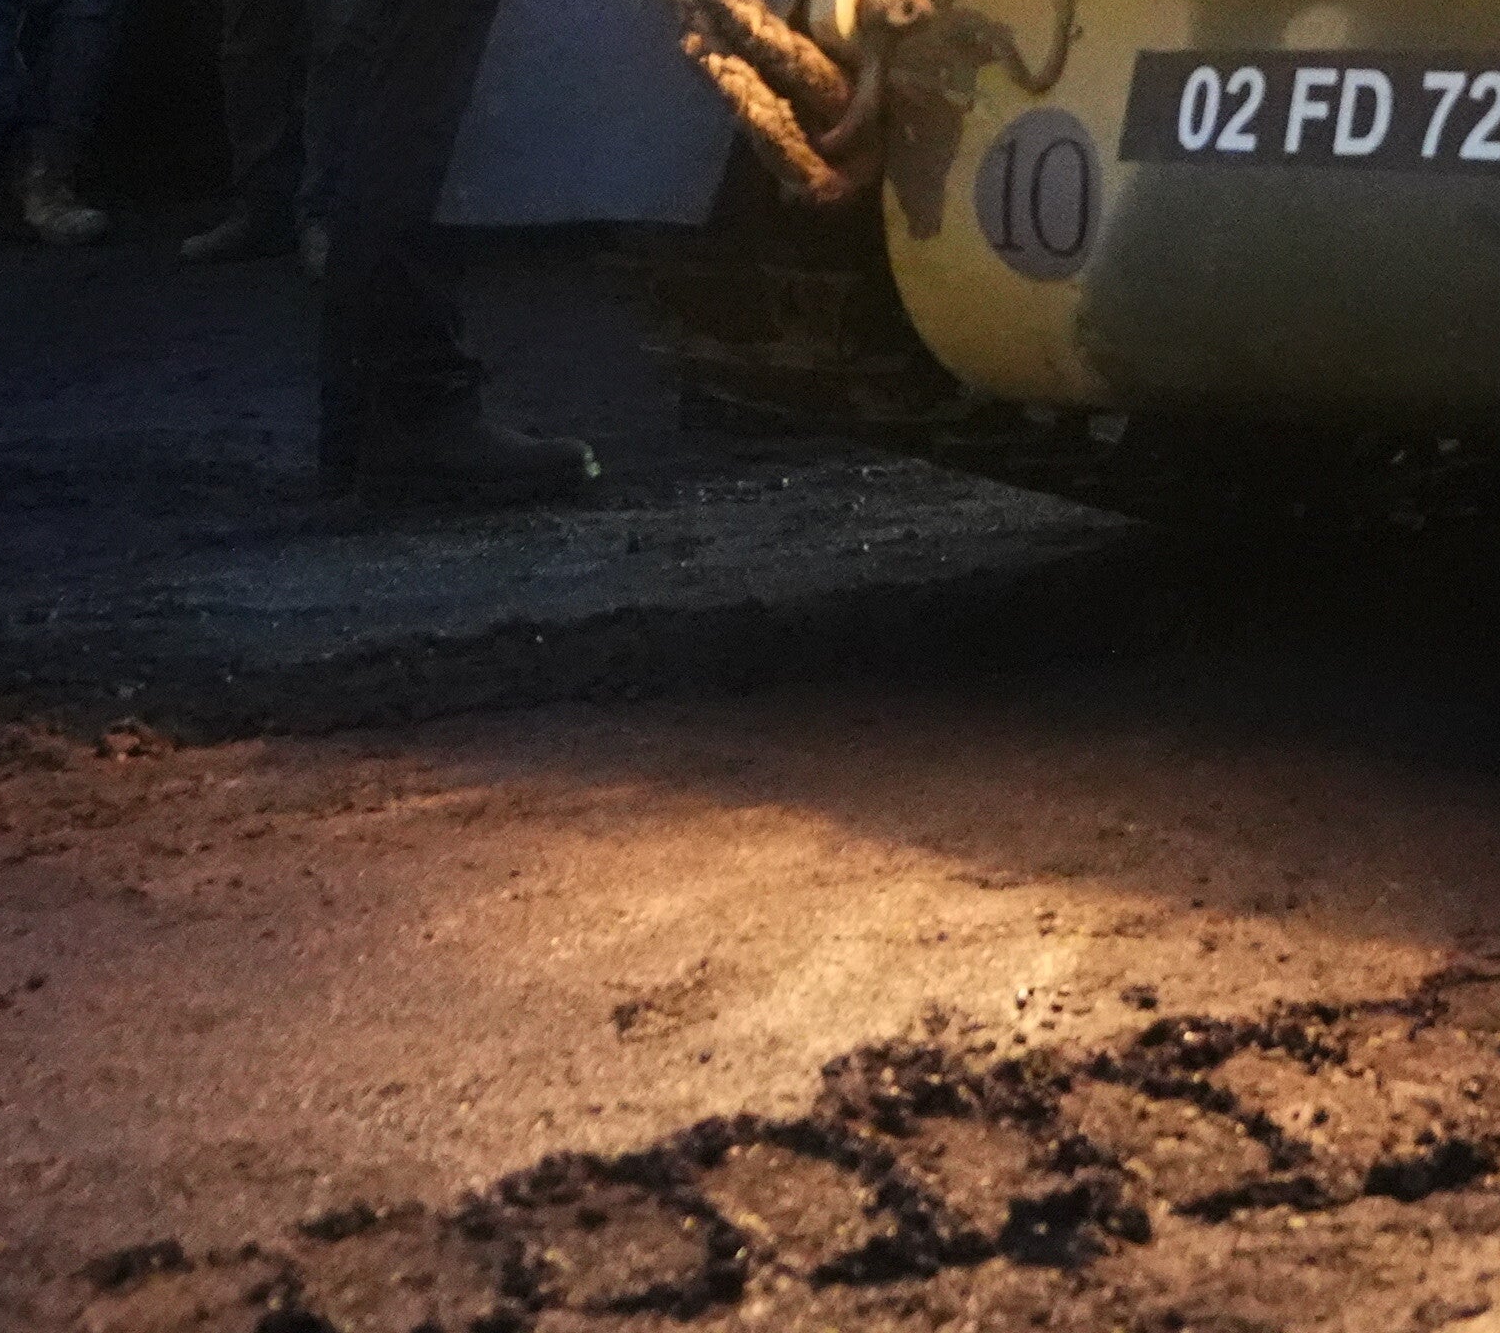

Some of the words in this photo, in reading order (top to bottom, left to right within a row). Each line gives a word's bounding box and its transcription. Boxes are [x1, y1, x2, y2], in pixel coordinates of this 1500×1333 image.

[1177, 65, 1267, 152] 02
[1283, 66, 1394, 157] FD
[992, 136, 1090, 259] 10
